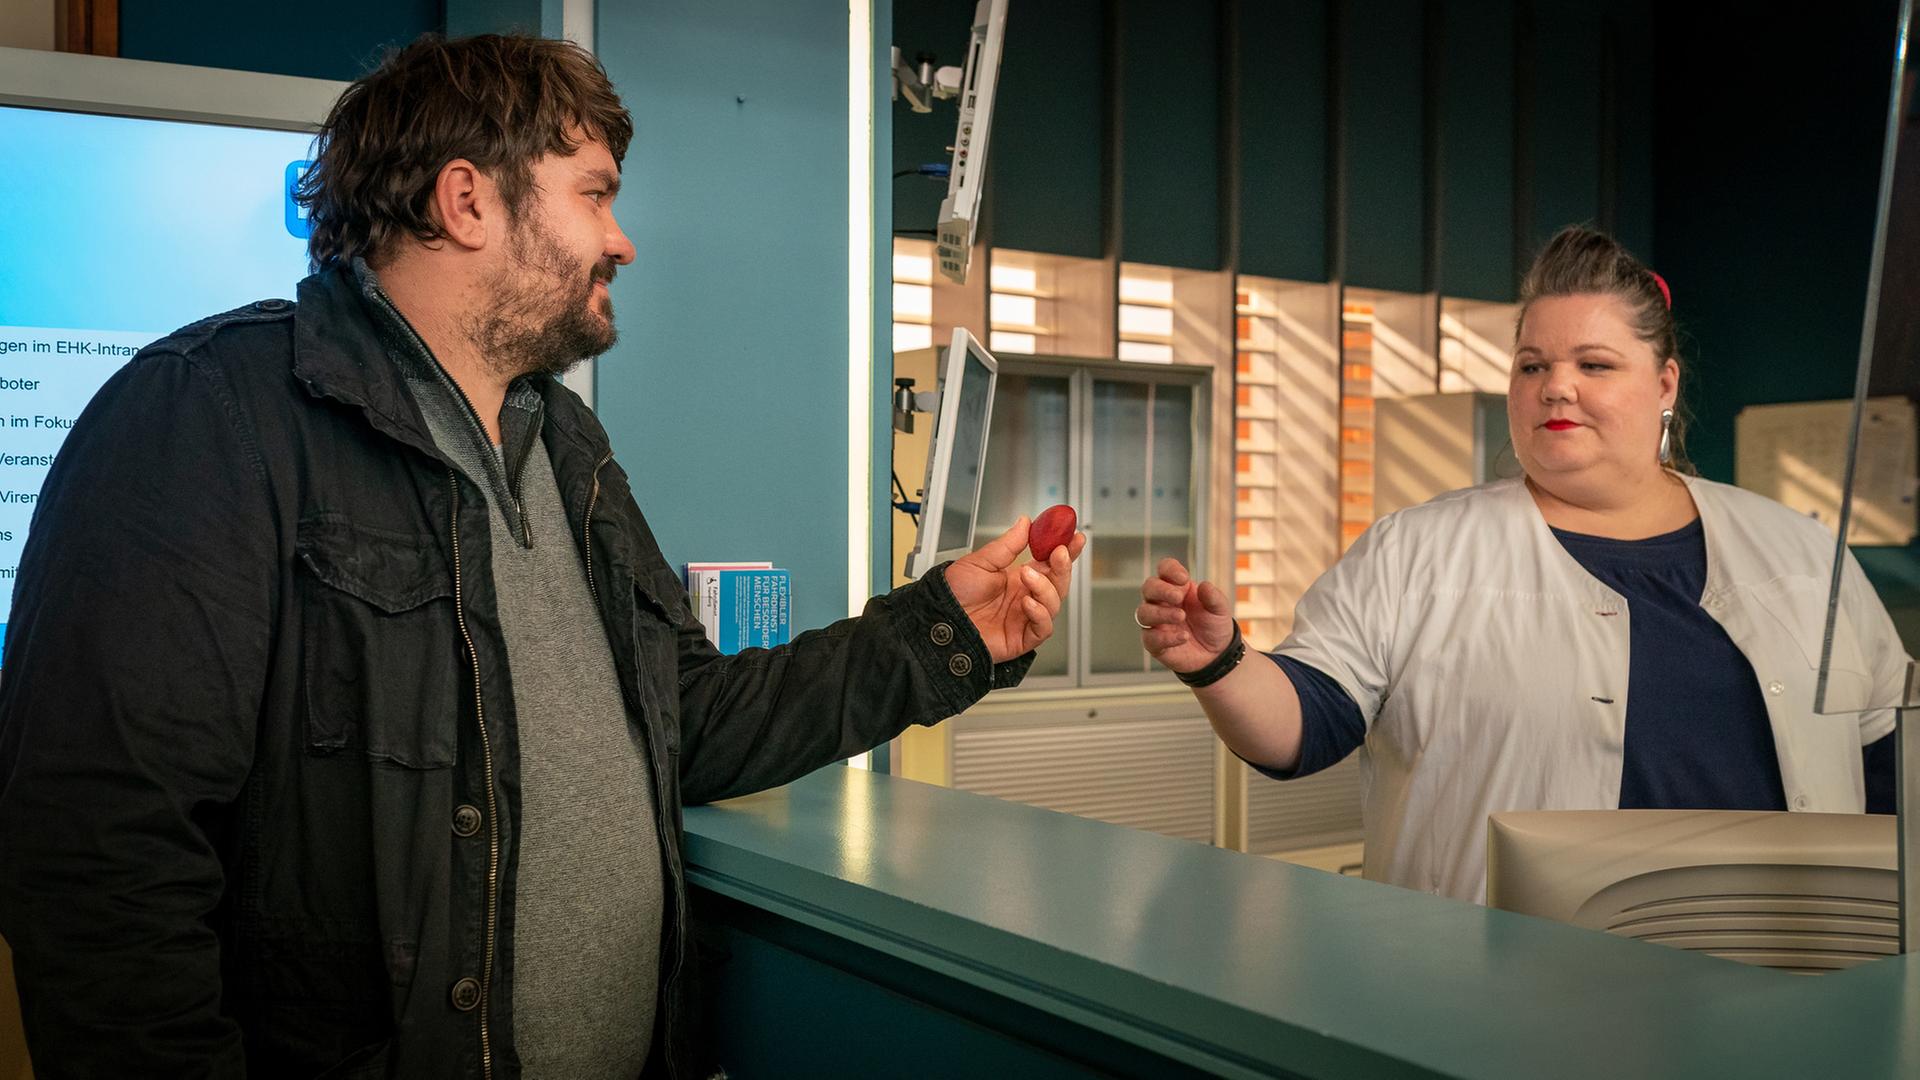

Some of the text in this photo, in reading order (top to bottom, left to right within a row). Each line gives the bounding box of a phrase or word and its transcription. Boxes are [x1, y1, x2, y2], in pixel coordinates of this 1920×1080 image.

[33, 340, 51, 353] im
[0, 377, 40, 390] boter
[10, 415, 29, 428] im
[762, 576, 770, 594] FÜR
[779, 575, 787, 625] FLEXIBLER
